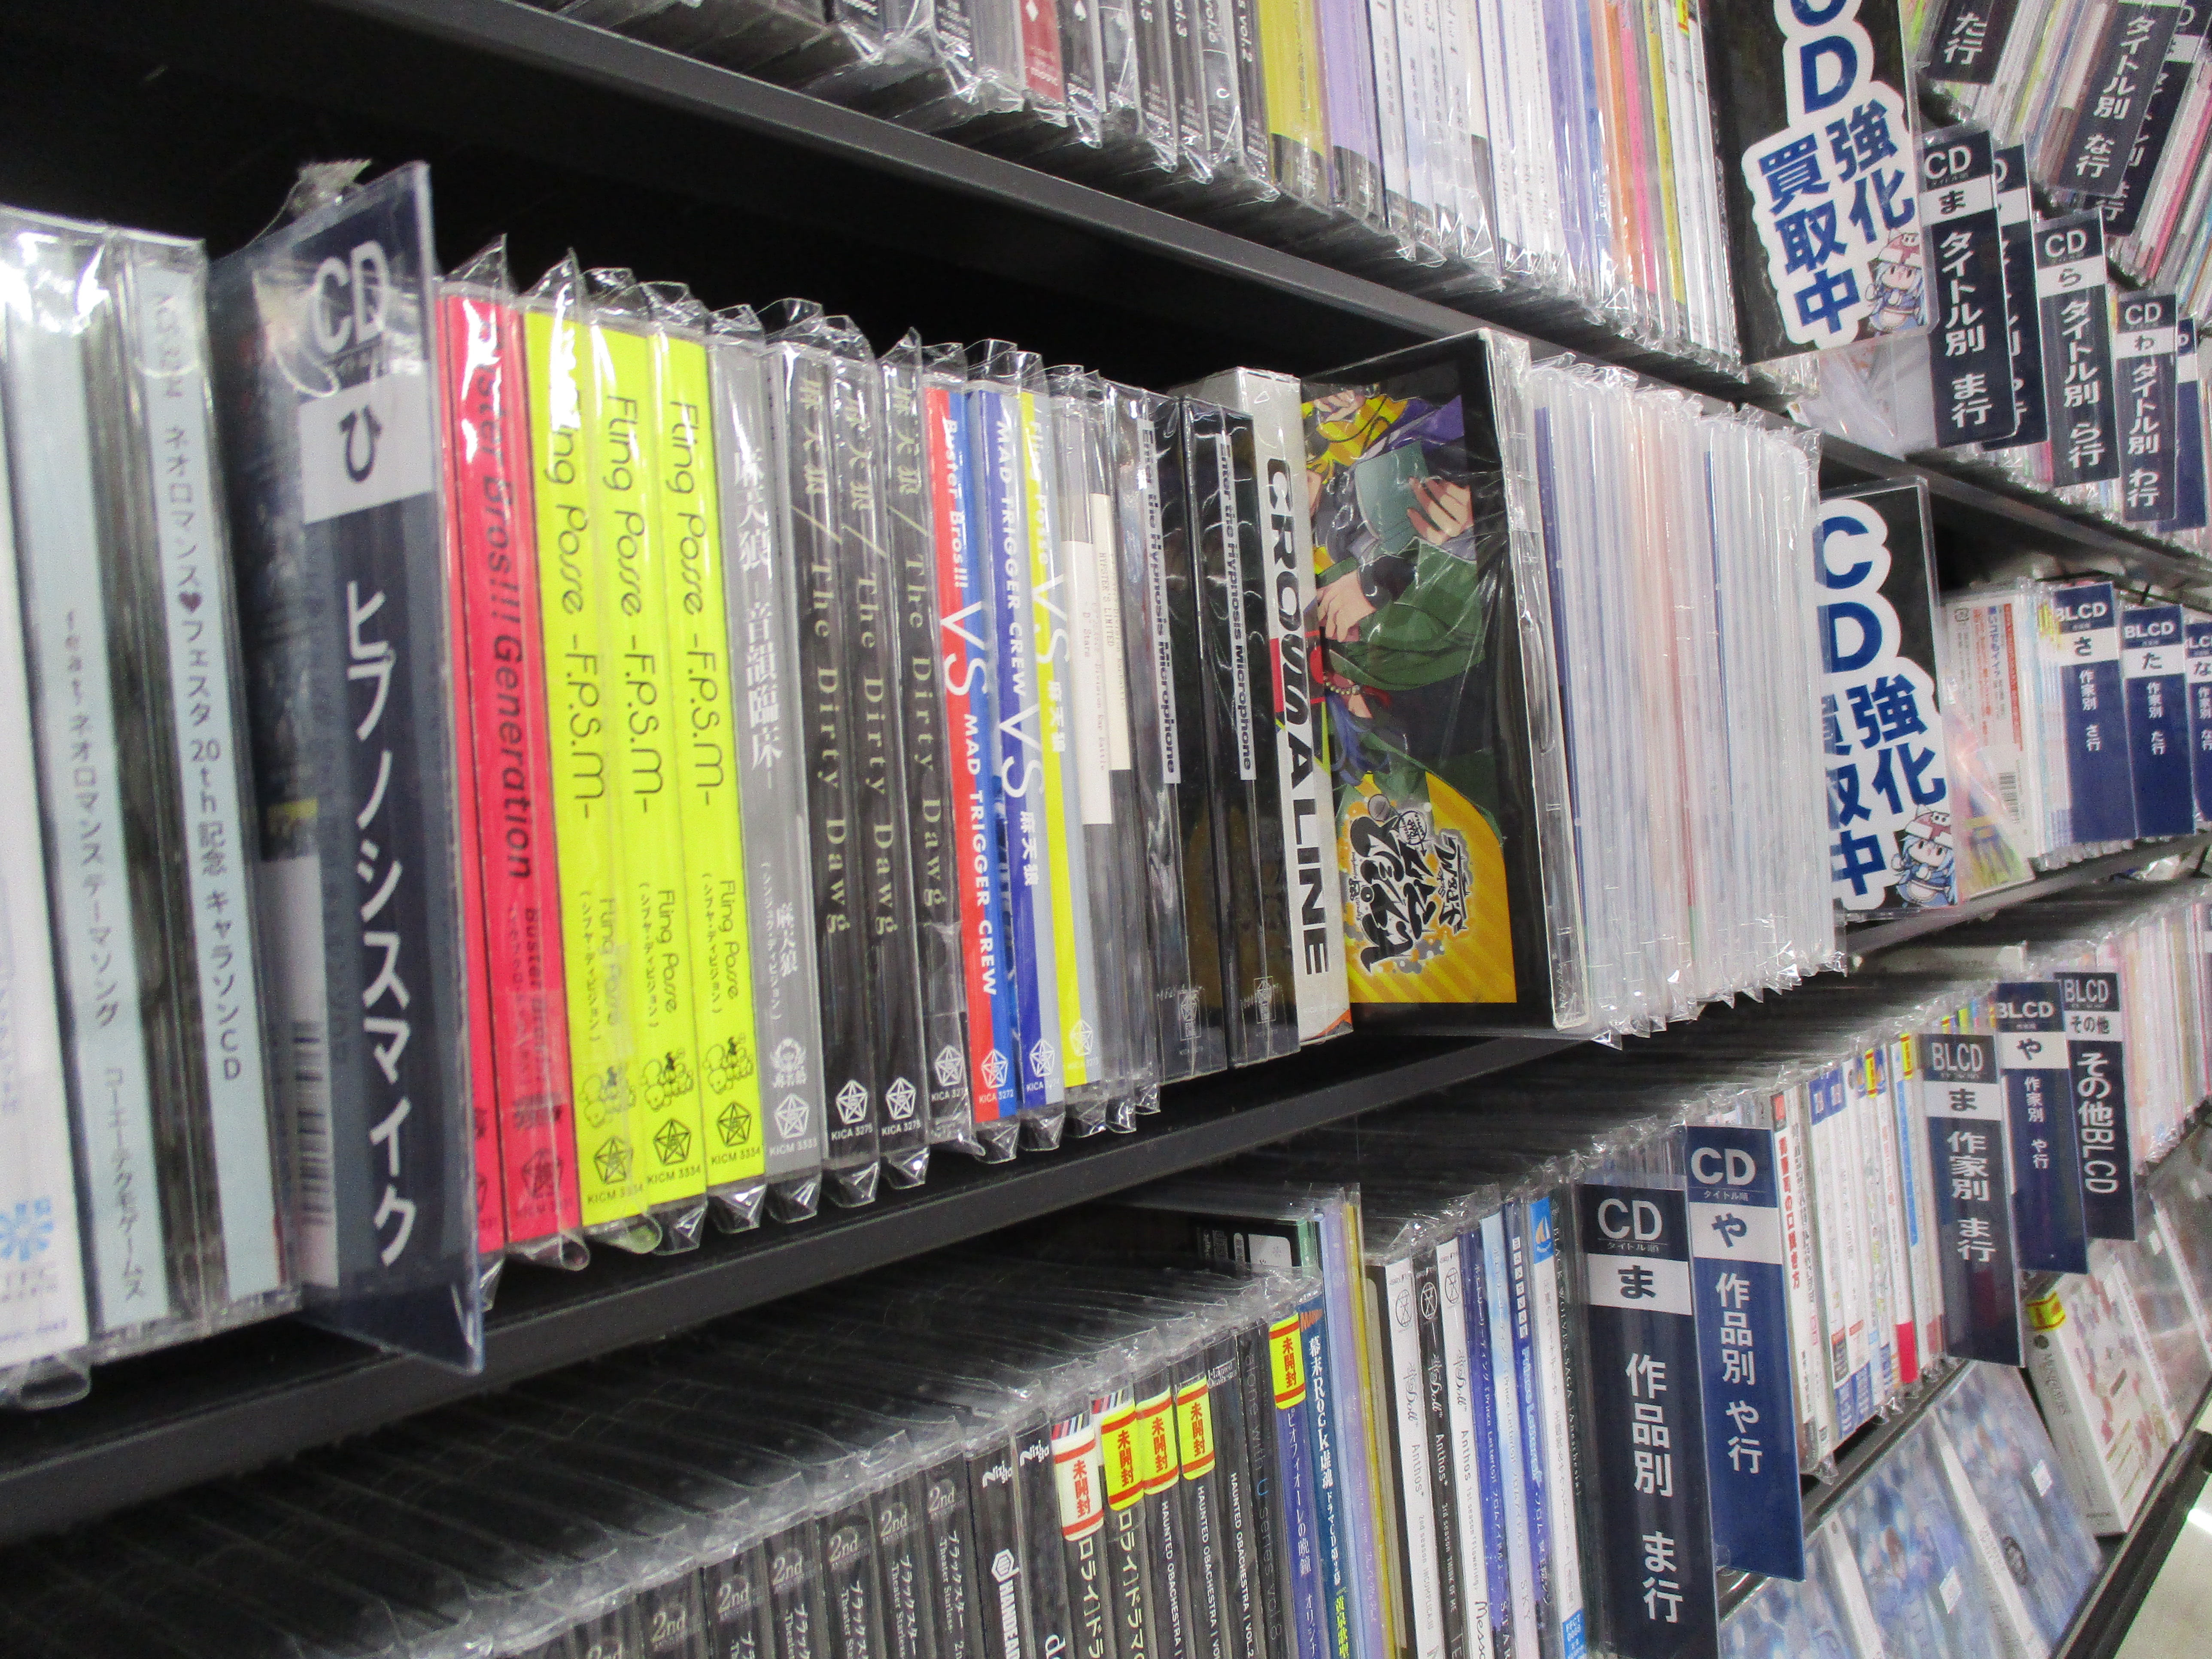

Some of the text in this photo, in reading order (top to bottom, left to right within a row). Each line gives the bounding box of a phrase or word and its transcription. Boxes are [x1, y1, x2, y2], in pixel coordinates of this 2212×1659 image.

[1944, 11, 1987, 65] た行
[2075, 14, 2156, 179] タイトル別 な行
[1826, 98, 1915, 245] 強化
[1924, 145, 1972, 179] CD
[1757, 132, 1860, 334] 買取中
[1938, 190, 1966, 215] ま
[2044, 233, 2087, 259] CD
[2058, 267, 2082, 287] ら
[314, 240, 390, 355] CD
[1940, 231, 1993, 428] タイトル別 ま行
[2124, 302, 2162, 326] CD
[2134, 335, 2156, 351] わ
[2060, 300, 2106, 468] タイトル別 ら行
[339, 404, 382, 483] ひ
[603, 394, 639, 492] Fling
[665, 401, 700, 494] Fling
[995, 420, 1013, 487] MAD
[2127, 364, 2162, 509] タイトル別 わ行
[483, 475, 520, 623] Bros!!!
[555, 503, 589, 616] Posse
[614, 510, 646, 616] Posse
[678, 512, 707, 616] Posse
[949, 511, 969, 588] Bros!!!
[1000, 497, 1021, 609] TRIGGER
[1031, 574, 1070, 664] VS
[1218, 444, 1253, 771] Enter the Hypnosis Microphone
[1813, 516, 1883, 675] CD
[2053, 601, 2108, 622] BLCD
[2124, 620, 2176, 639] BLCD
[939, 601, 988, 696] VS
[1008, 614, 1027, 696] CREW
[1149, 533, 1175, 774] Hypnosis Microphone
[2073, 636, 2093, 656] さ
[2141, 652, 2164, 670] た
[494, 634, 531, 880] Generation
[811, 558, 851, 935] The Dirty Dawg
[858, 571, 899, 935] The Dirty Dawg
[905, 553, 946, 907] The Dirty Dawg
[963, 714, 981, 775] MAD
[999, 703, 1045, 798] VS
[1848, 674, 1946, 814] 強化
[969, 790, 990, 907] TRIGGER
[347, 580, 417, 1267] ヒプノシスマイク
[656, 888, 677, 945] Fling
[718, 879, 741, 1000] Fling Posse
[978, 919, 998, 995] CREW
[2064, 978, 2109, 1004] BLCD
[1995, 1001, 2054, 1020] BLCD
[2069, 1015, 2110, 1035] その他
[1932, 1042, 1984, 1073] BLCD
[2016, 1038, 2043, 1061] や
[931, 1090, 950, 1103] KICA
[979, 1091, 997, 1103] KICA
[1026, 1082, 1044, 1093] KICA
[1948, 1088, 1978, 1112] ま
[2024, 1076, 2049, 1170] 作家別 や行
[2076, 1051, 2119, 1196] その他BLCD
[711, 1146, 763, 1165] KICM 3334
[769, 1142, 795, 1157] KICM
[831, 1127, 854, 1142] KICA
[881, 1124, 902, 1138] KICA
[1690, 1146, 1756, 1188] CD
[647, 1164, 702, 1185] KICM 3334
[1947, 1130, 1996, 1263] 作家別 ま行
[1597, 1198, 1663, 1243] CD
[1712, 1212, 1748, 1249] や
[1618, 1264, 1656, 1300] ま
[1282, 1337, 1297, 1389] 未開封
[1716, 1271, 1764, 1476] 作品別 や行
[1117, 1430, 1135, 1487] 未開封
[1152, 1417, 1168, 1473] 未開封
[1190, 1401, 1206, 1458] 未開封
[1460, 1429, 1472, 1481] Anthos
[1073, 1459, 1091, 1519] 未開封
[1257, 1478, 1268, 1497] U
[1626, 1353, 1684, 1623] 作品別 ま行
[1161, 1501, 1181, 1649] HAUNTED OBACHESTRA
[1197, 1485, 1218, 1629] HAUNTED OBACHESTRA
[1230, 1472, 1255, 1659] HAUNTED OBACHESTRA VOL.2
[1259, 1507, 1273, 1576] series
